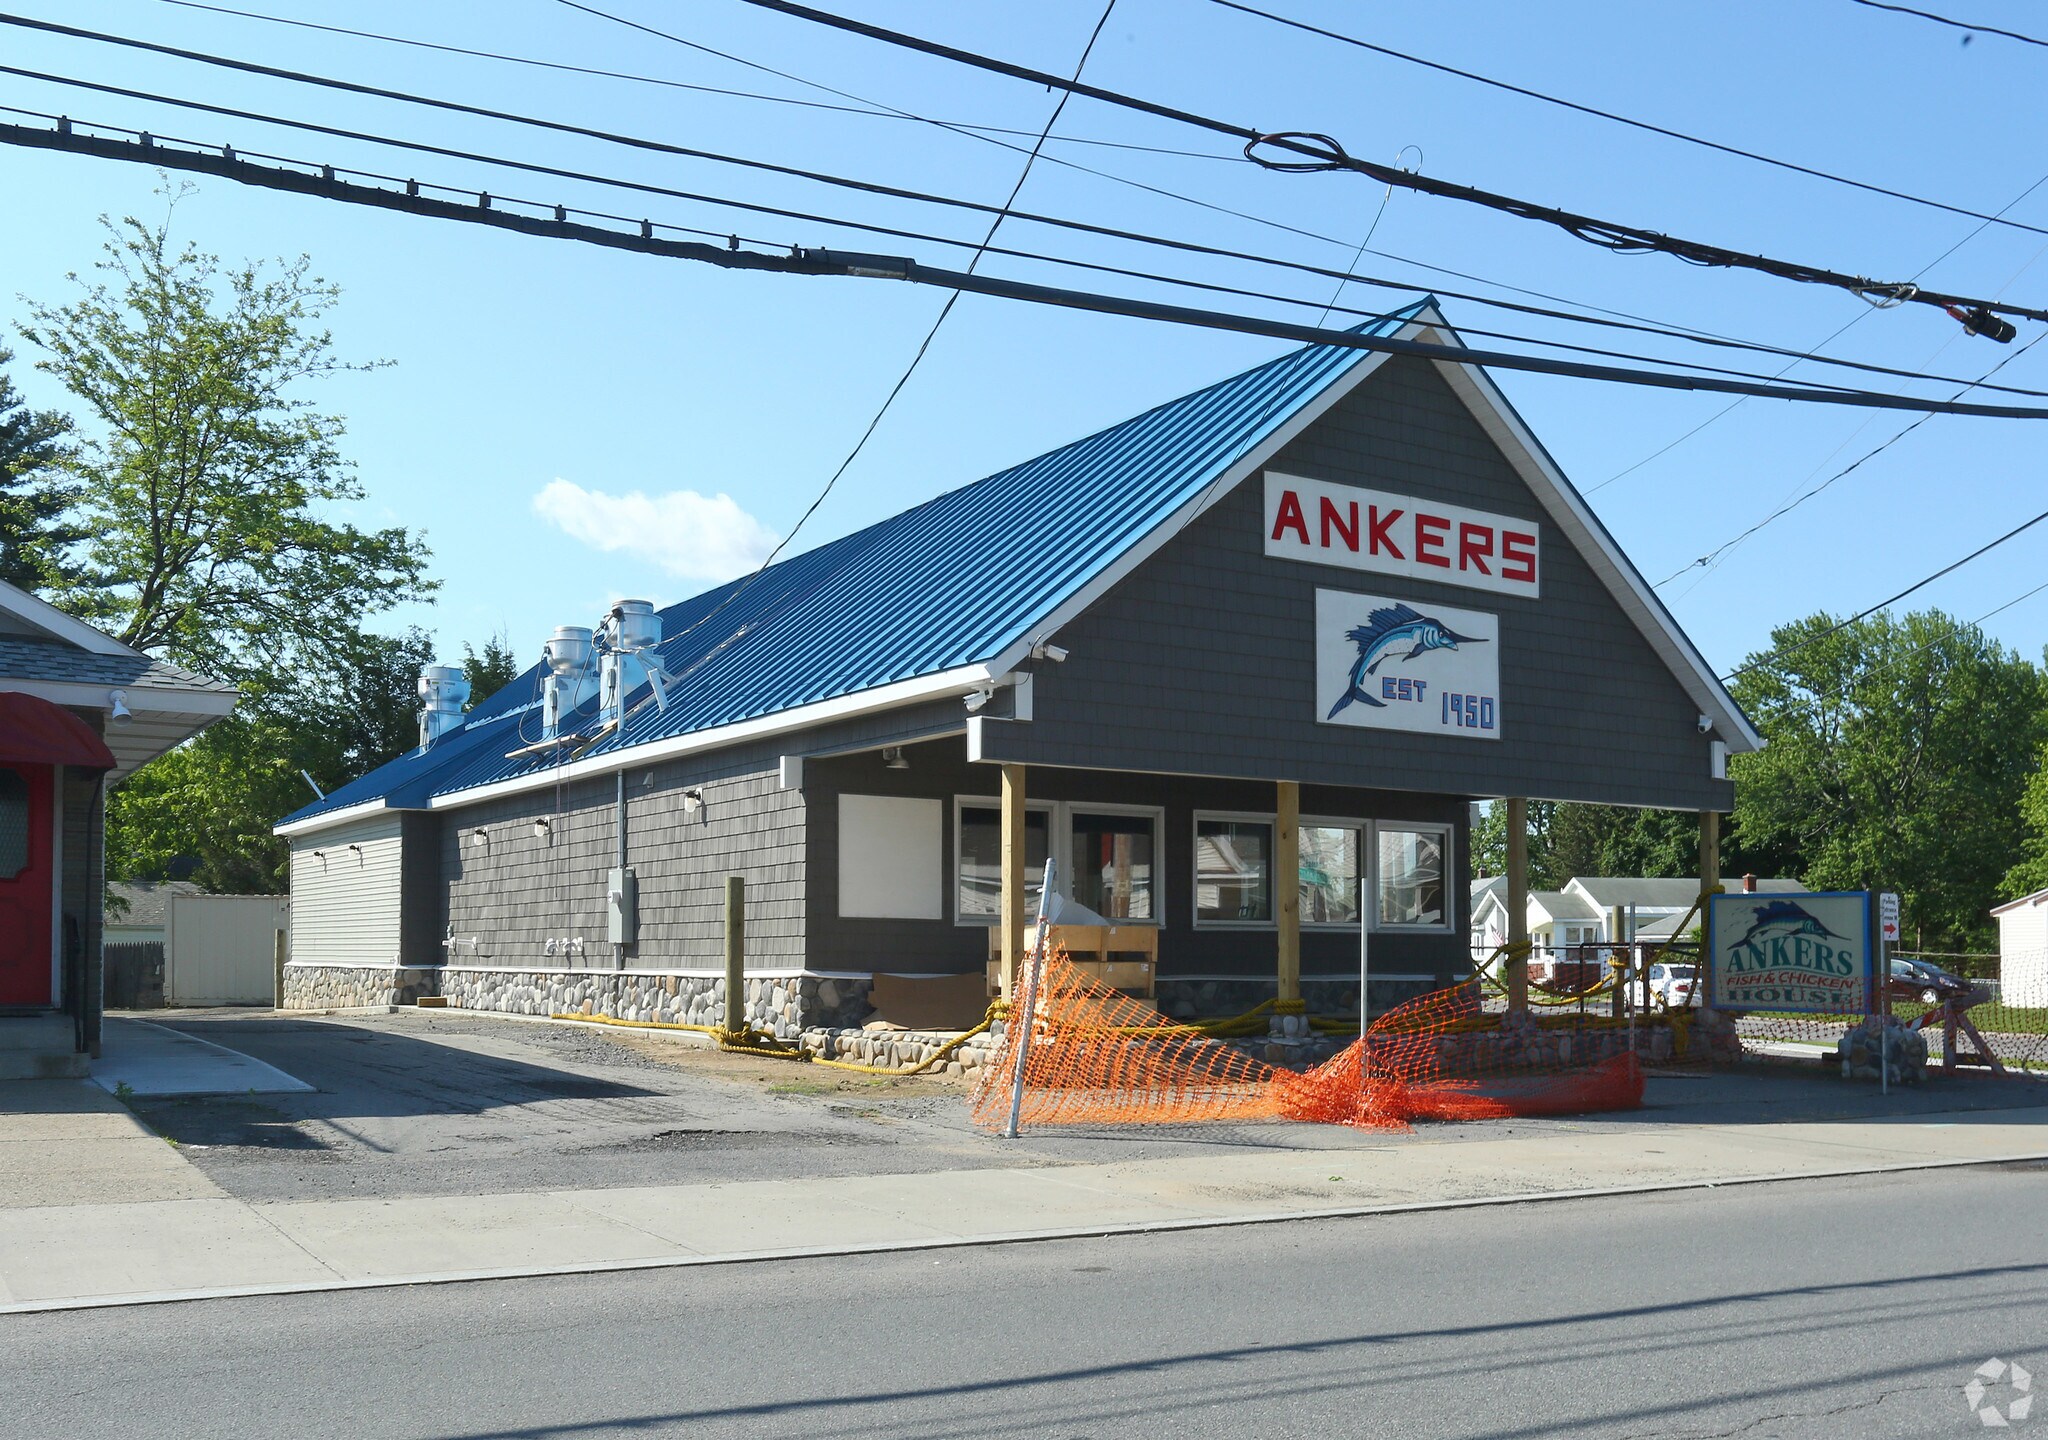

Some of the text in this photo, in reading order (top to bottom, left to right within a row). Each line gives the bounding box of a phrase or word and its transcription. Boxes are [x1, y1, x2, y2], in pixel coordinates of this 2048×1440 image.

[1271, 490, 1536, 583] ANKERS
[1382, 676, 1495, 729] EST 1950
[1725, 936, 1854, 977] ANKERS
[1727, 971, 1853, 989] FISH & CHICKEN
[1728, 988, 1852, 1004] HOUSE
